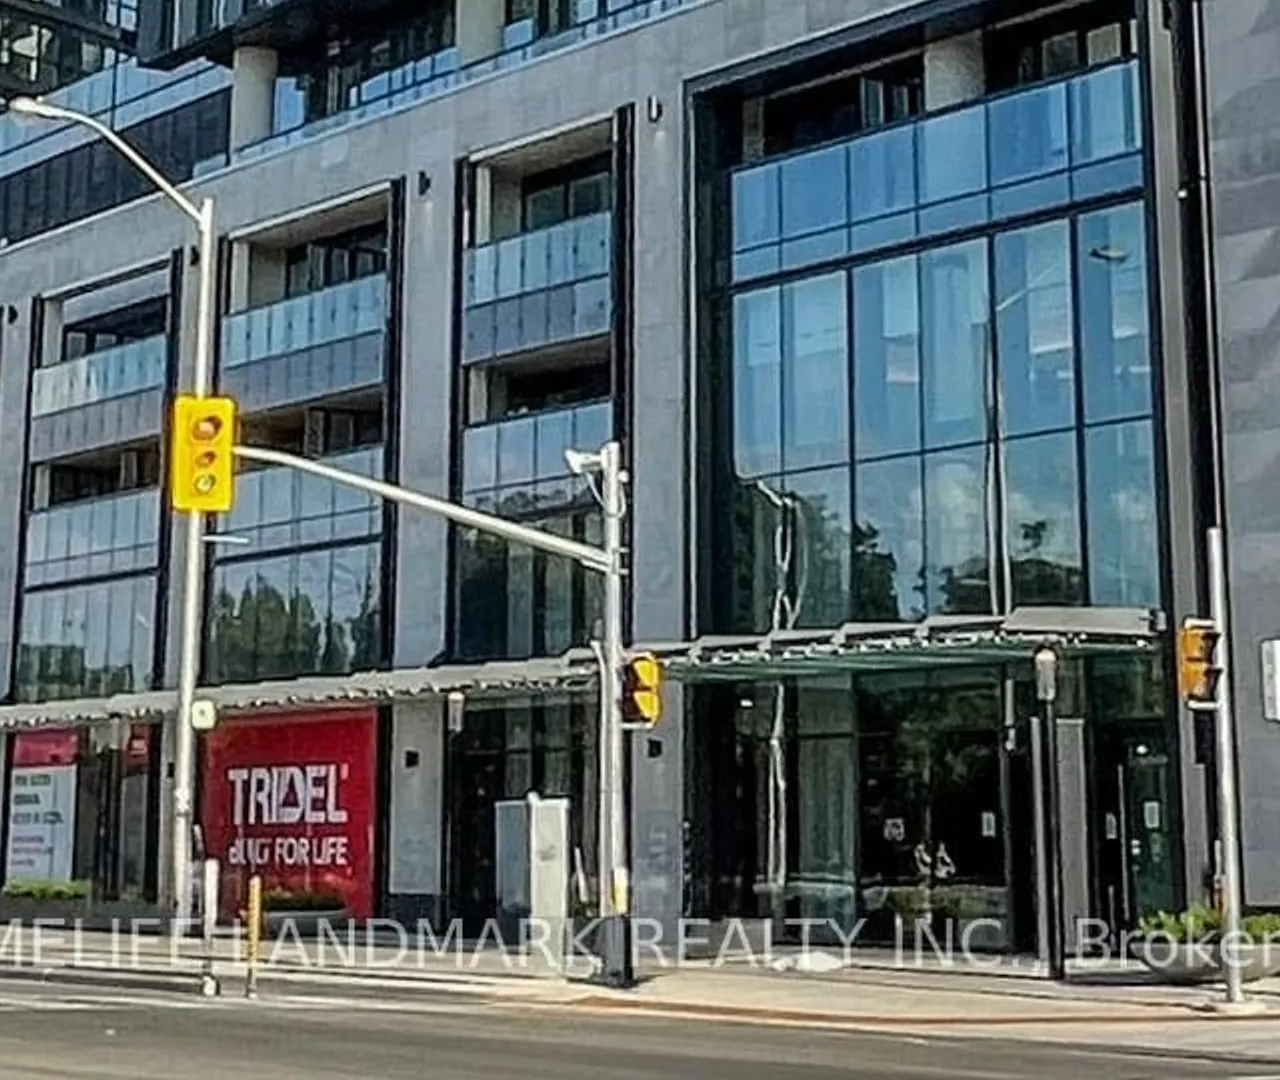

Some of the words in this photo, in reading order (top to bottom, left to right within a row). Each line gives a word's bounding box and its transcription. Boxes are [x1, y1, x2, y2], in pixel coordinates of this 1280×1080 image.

[228, 764, 348, 825] TRIDEL
[275, 836, 311, 865] FOR
[312, 835, 348, 865] LIFE
